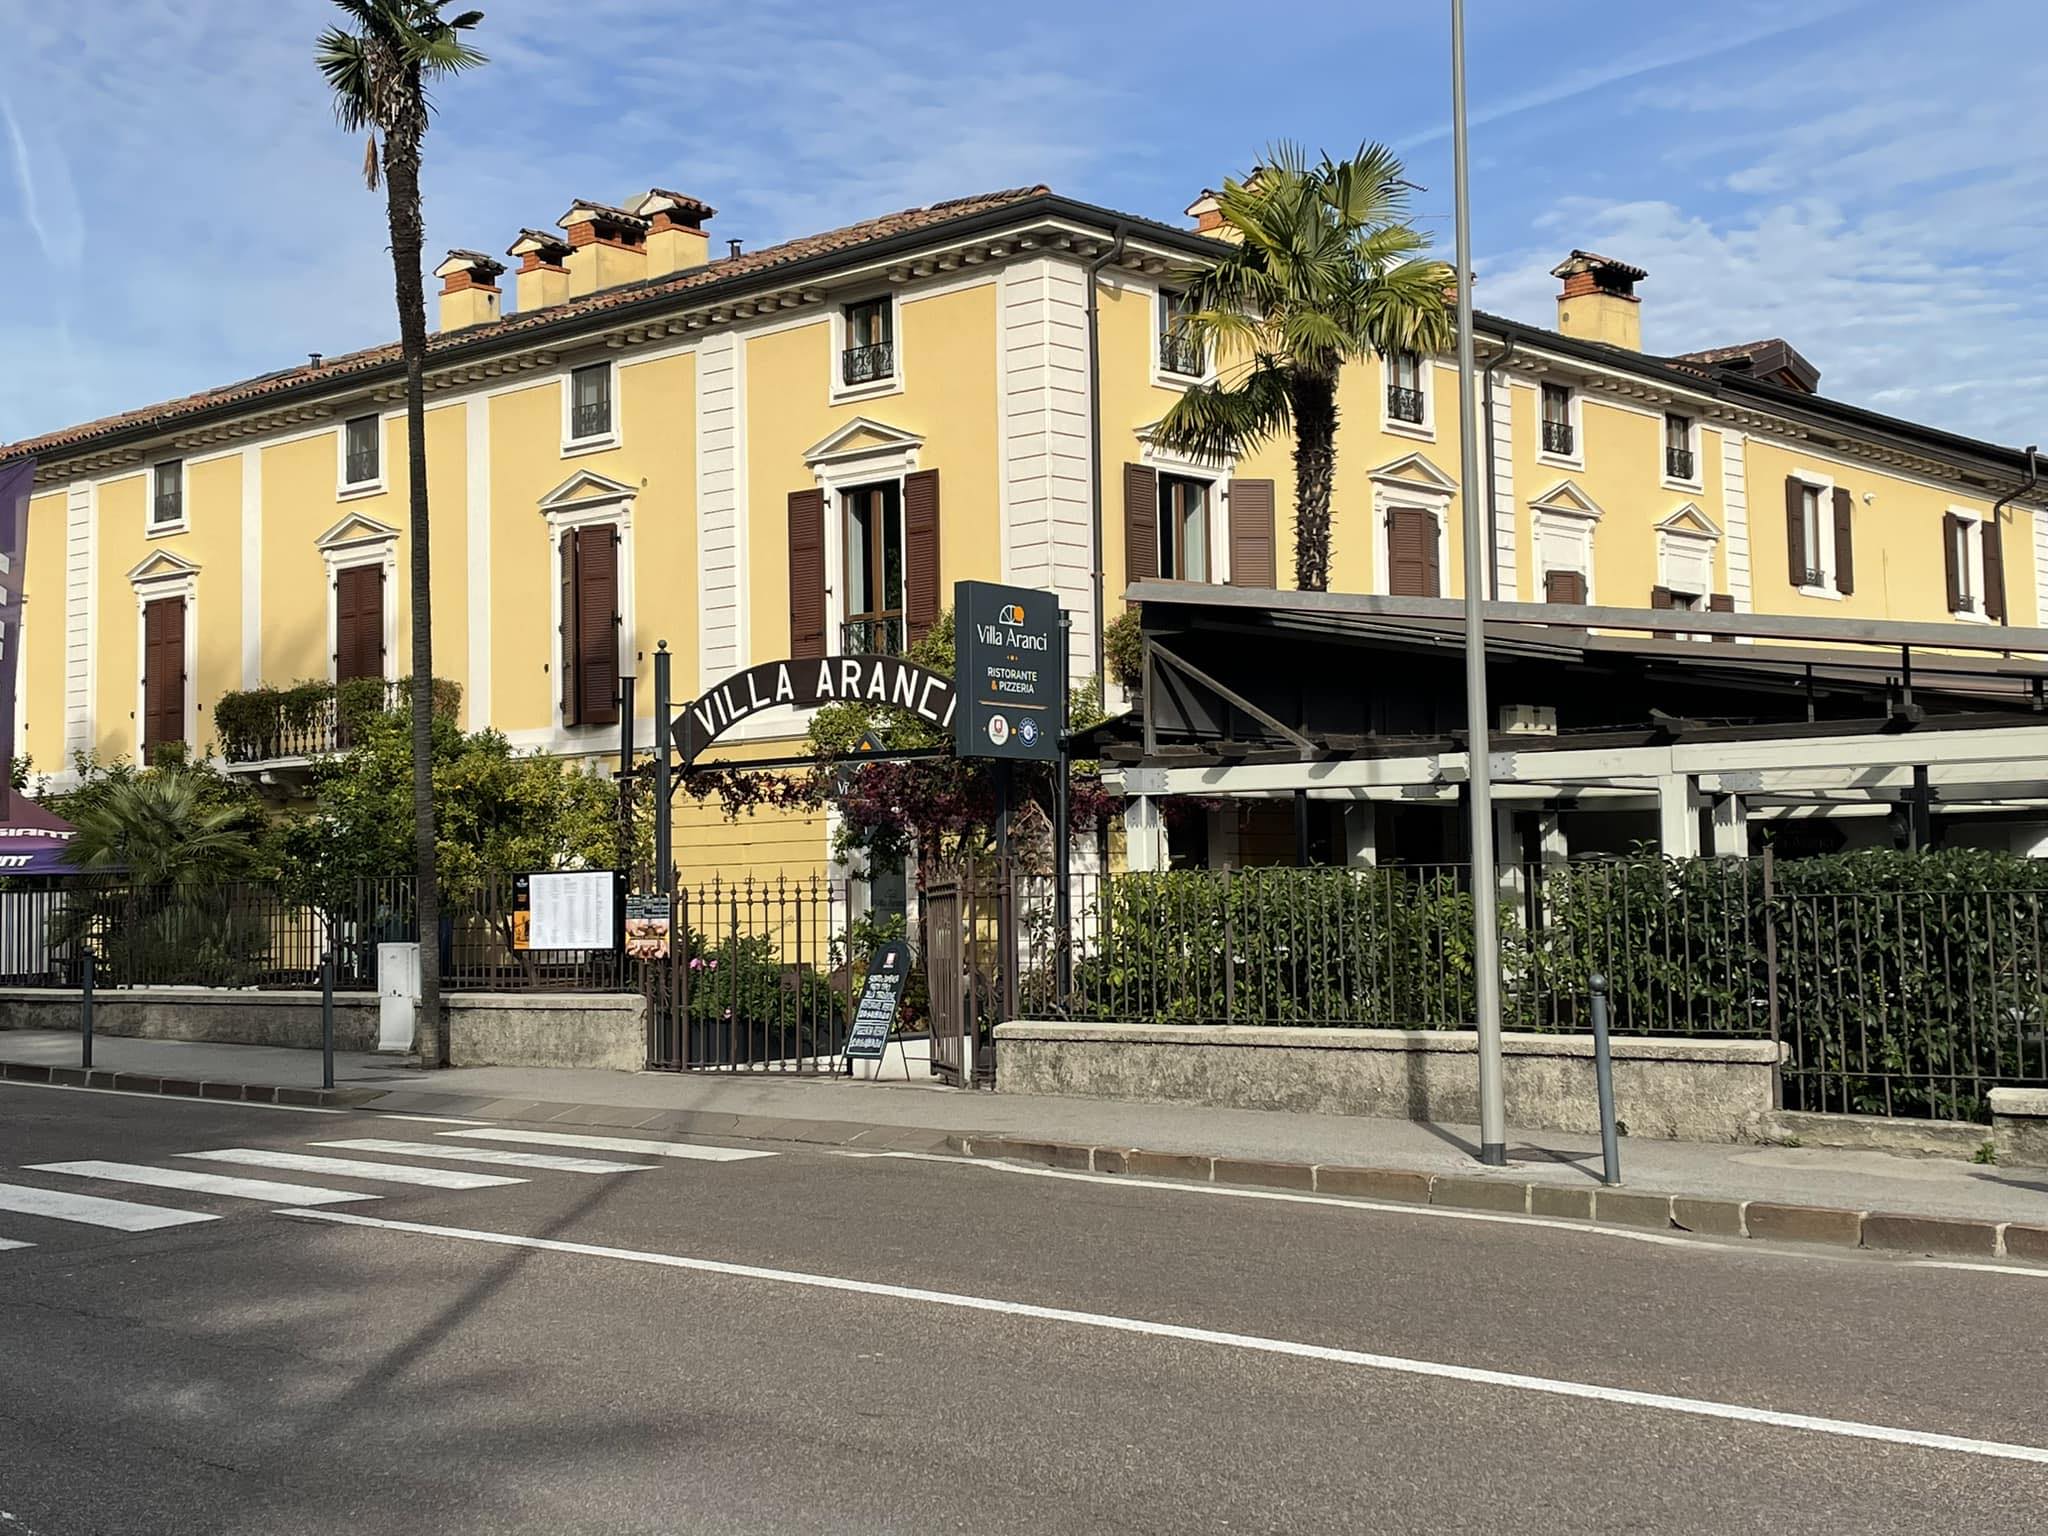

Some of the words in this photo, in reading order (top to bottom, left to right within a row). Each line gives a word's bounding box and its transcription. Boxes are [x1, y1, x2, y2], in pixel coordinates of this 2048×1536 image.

[977, 623, 1003, 645] Villa
[1006, 628, 1048, 651] Aranci
[987, 666, 1038, 682] RISTORANTE
[991, 680, 998, 691] &
[999, 681, 1035, 694] PIZZERIA
[694, 663, 795, 736] VILLA
